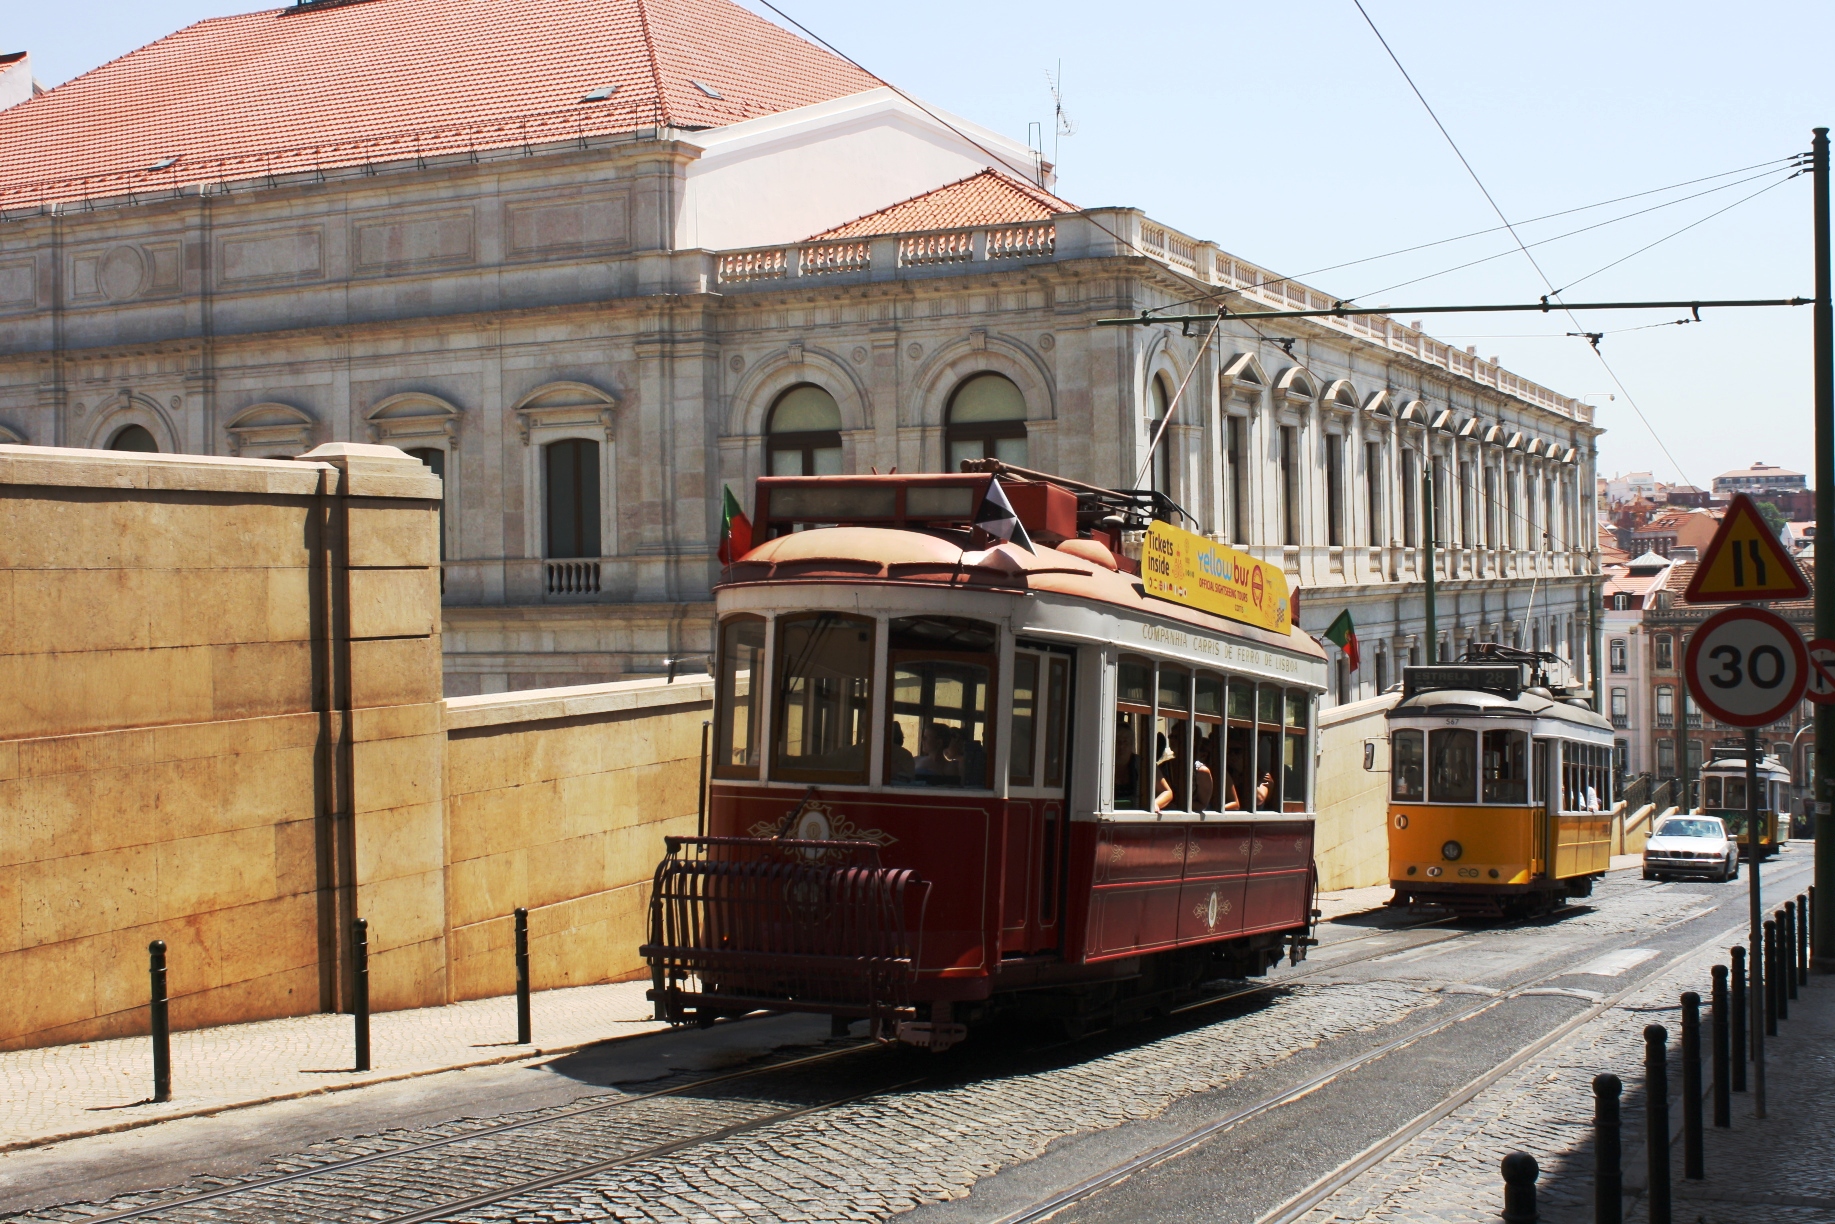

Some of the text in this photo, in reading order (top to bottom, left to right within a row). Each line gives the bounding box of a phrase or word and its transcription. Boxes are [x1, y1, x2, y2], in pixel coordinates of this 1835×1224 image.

[1148, 530, 1173, 556] Tickets
[1148, 551, 1169, 576] inside
[1199, 577, 1248, 603] OFFICIAL SIGHTSEEING TOURS
[1142, 624, 1298, 673] COMPANHIA CARRIS DE FERRO DE LISBOA
[1414, 672, 1470, 681] ESTRELA
[1485, 672, 1505, 684] 28
[1709, 644, 1785, 689] 30
